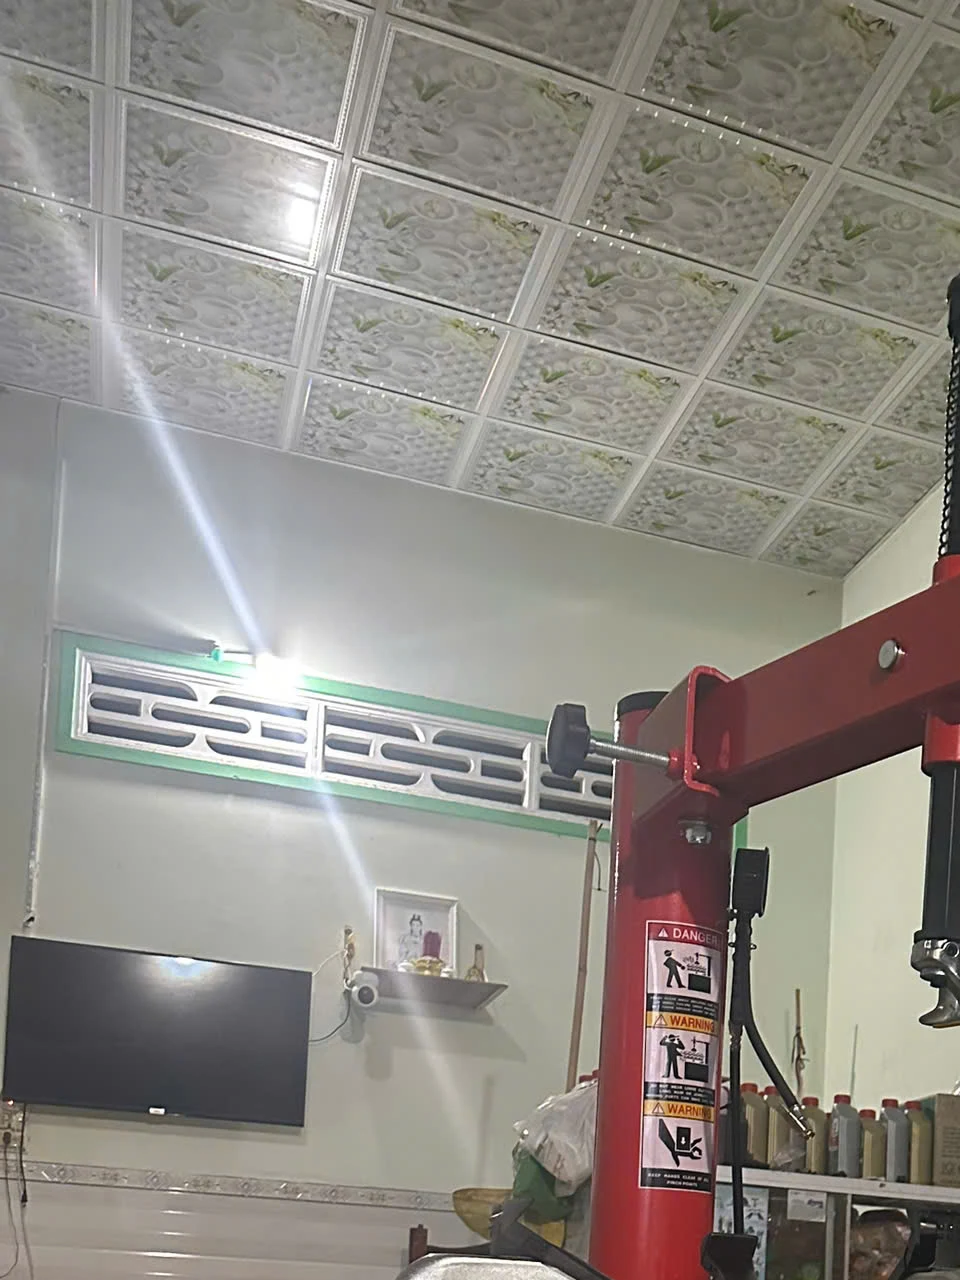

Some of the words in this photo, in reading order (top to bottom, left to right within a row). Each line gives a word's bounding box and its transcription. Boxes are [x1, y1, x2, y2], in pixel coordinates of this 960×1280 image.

[672, 927, 717, 945] DANGER
[670, 1015, 714, 1033] WARNING
[667, 1103, 712, 1120] WARNING
